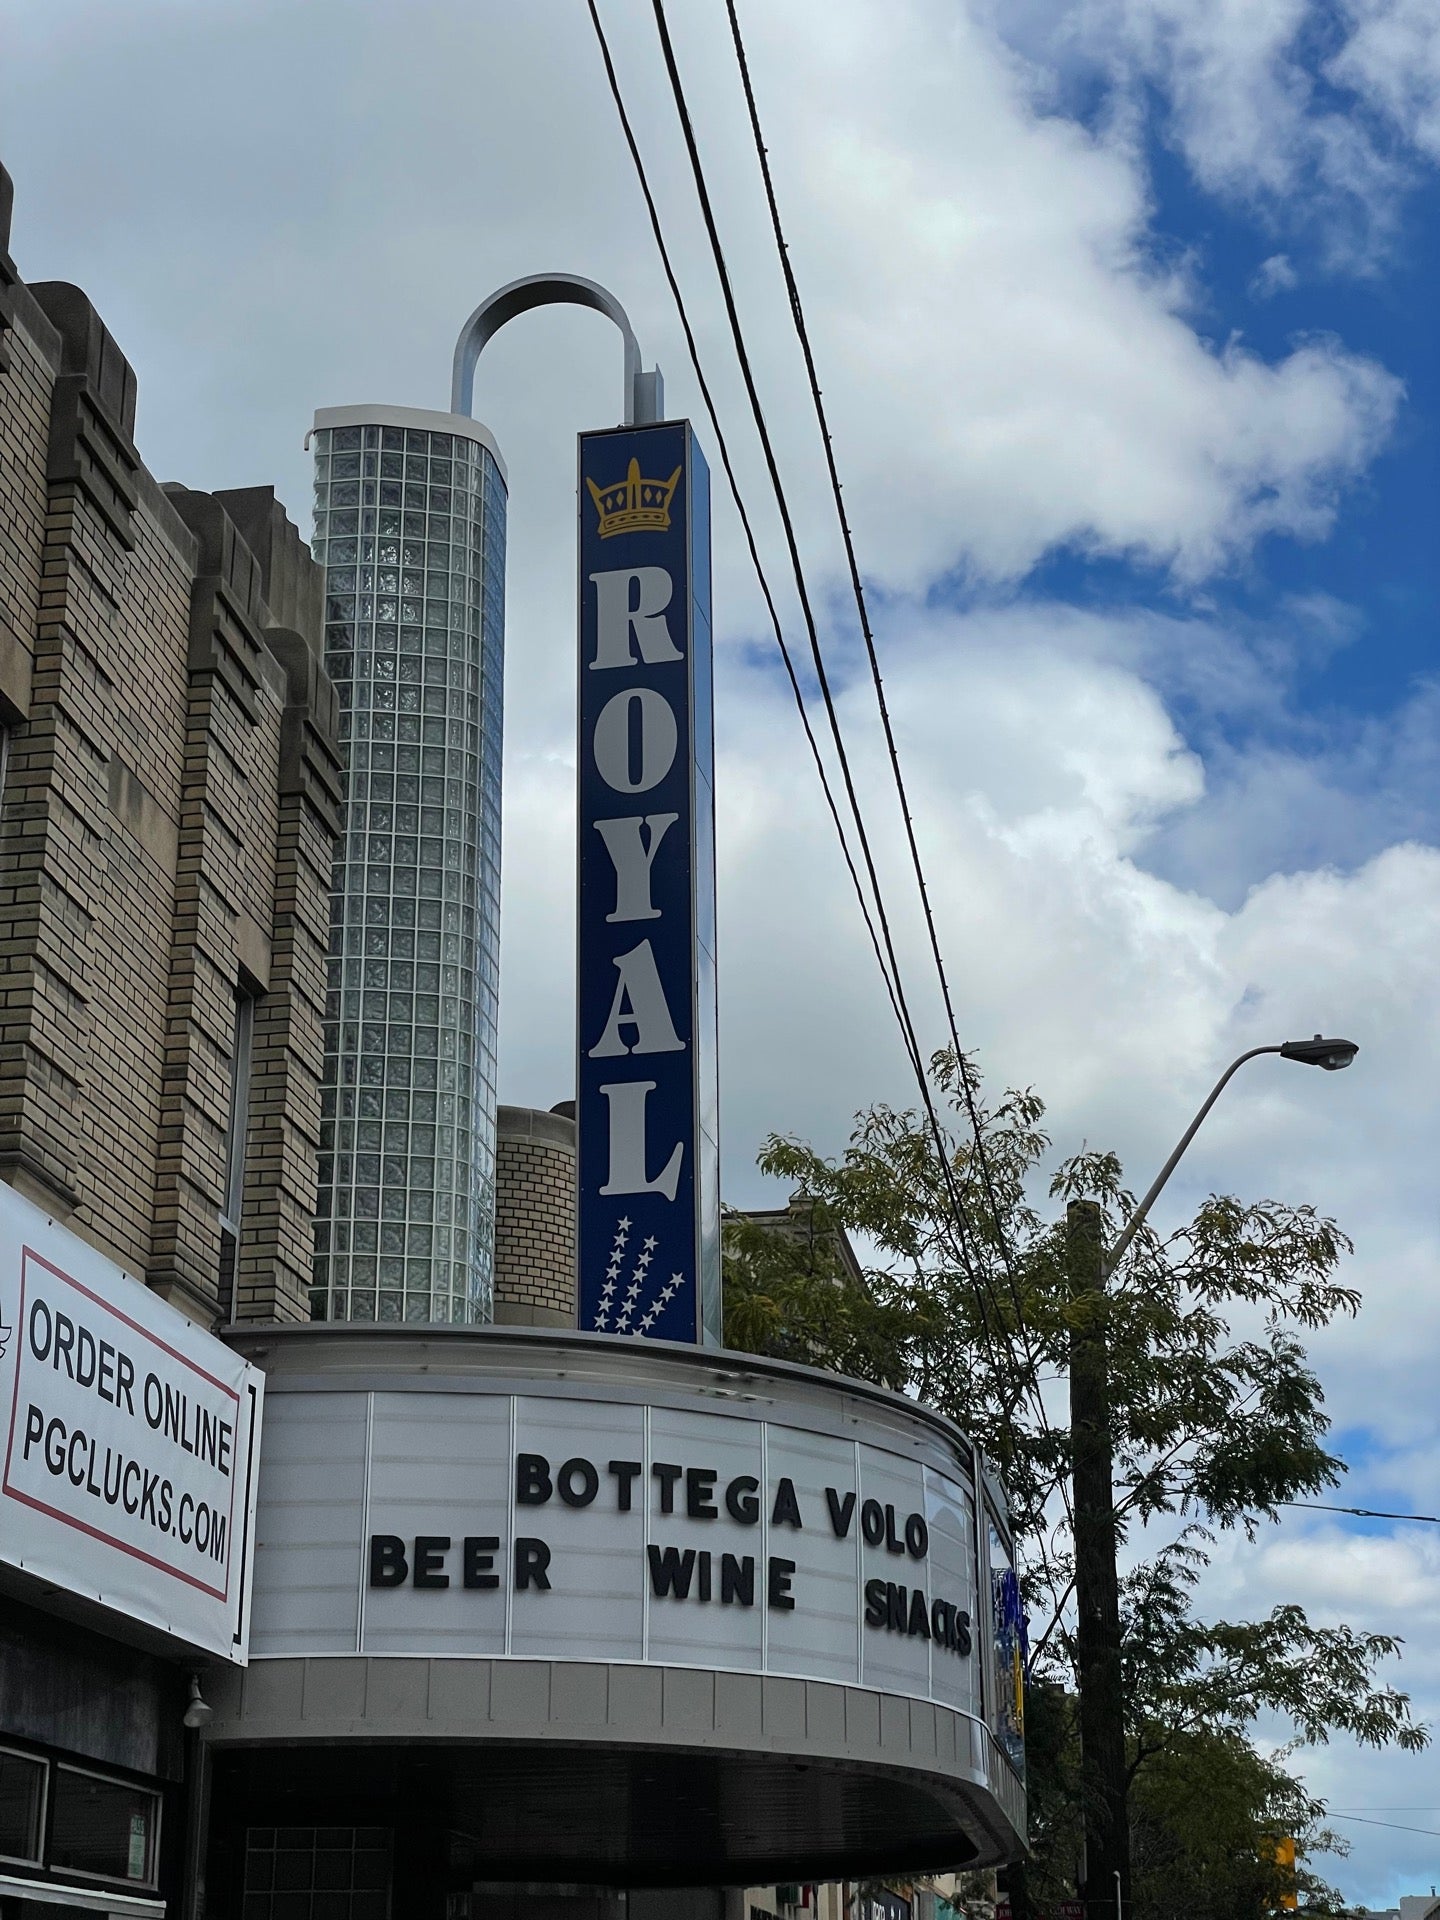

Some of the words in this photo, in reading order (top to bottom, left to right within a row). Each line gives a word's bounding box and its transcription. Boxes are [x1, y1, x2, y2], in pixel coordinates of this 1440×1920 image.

[588, 566, 686, 1201] ROYAL
[29, 1298, 135, 1416] ORDER
[144, 1372, 232, 1477] ONLINE
[23, 1403, 226, 1564] PGCLUCKS.COM
[517, 1453, 802, 1529] BOTTEGA
[826, 1487, 928, 1559] VOLO
[370, 1535, 551, 1590] BEER
[647, 1544, 796, 1609] WINE
[865, 1578, 971, 1656] SNACKS
